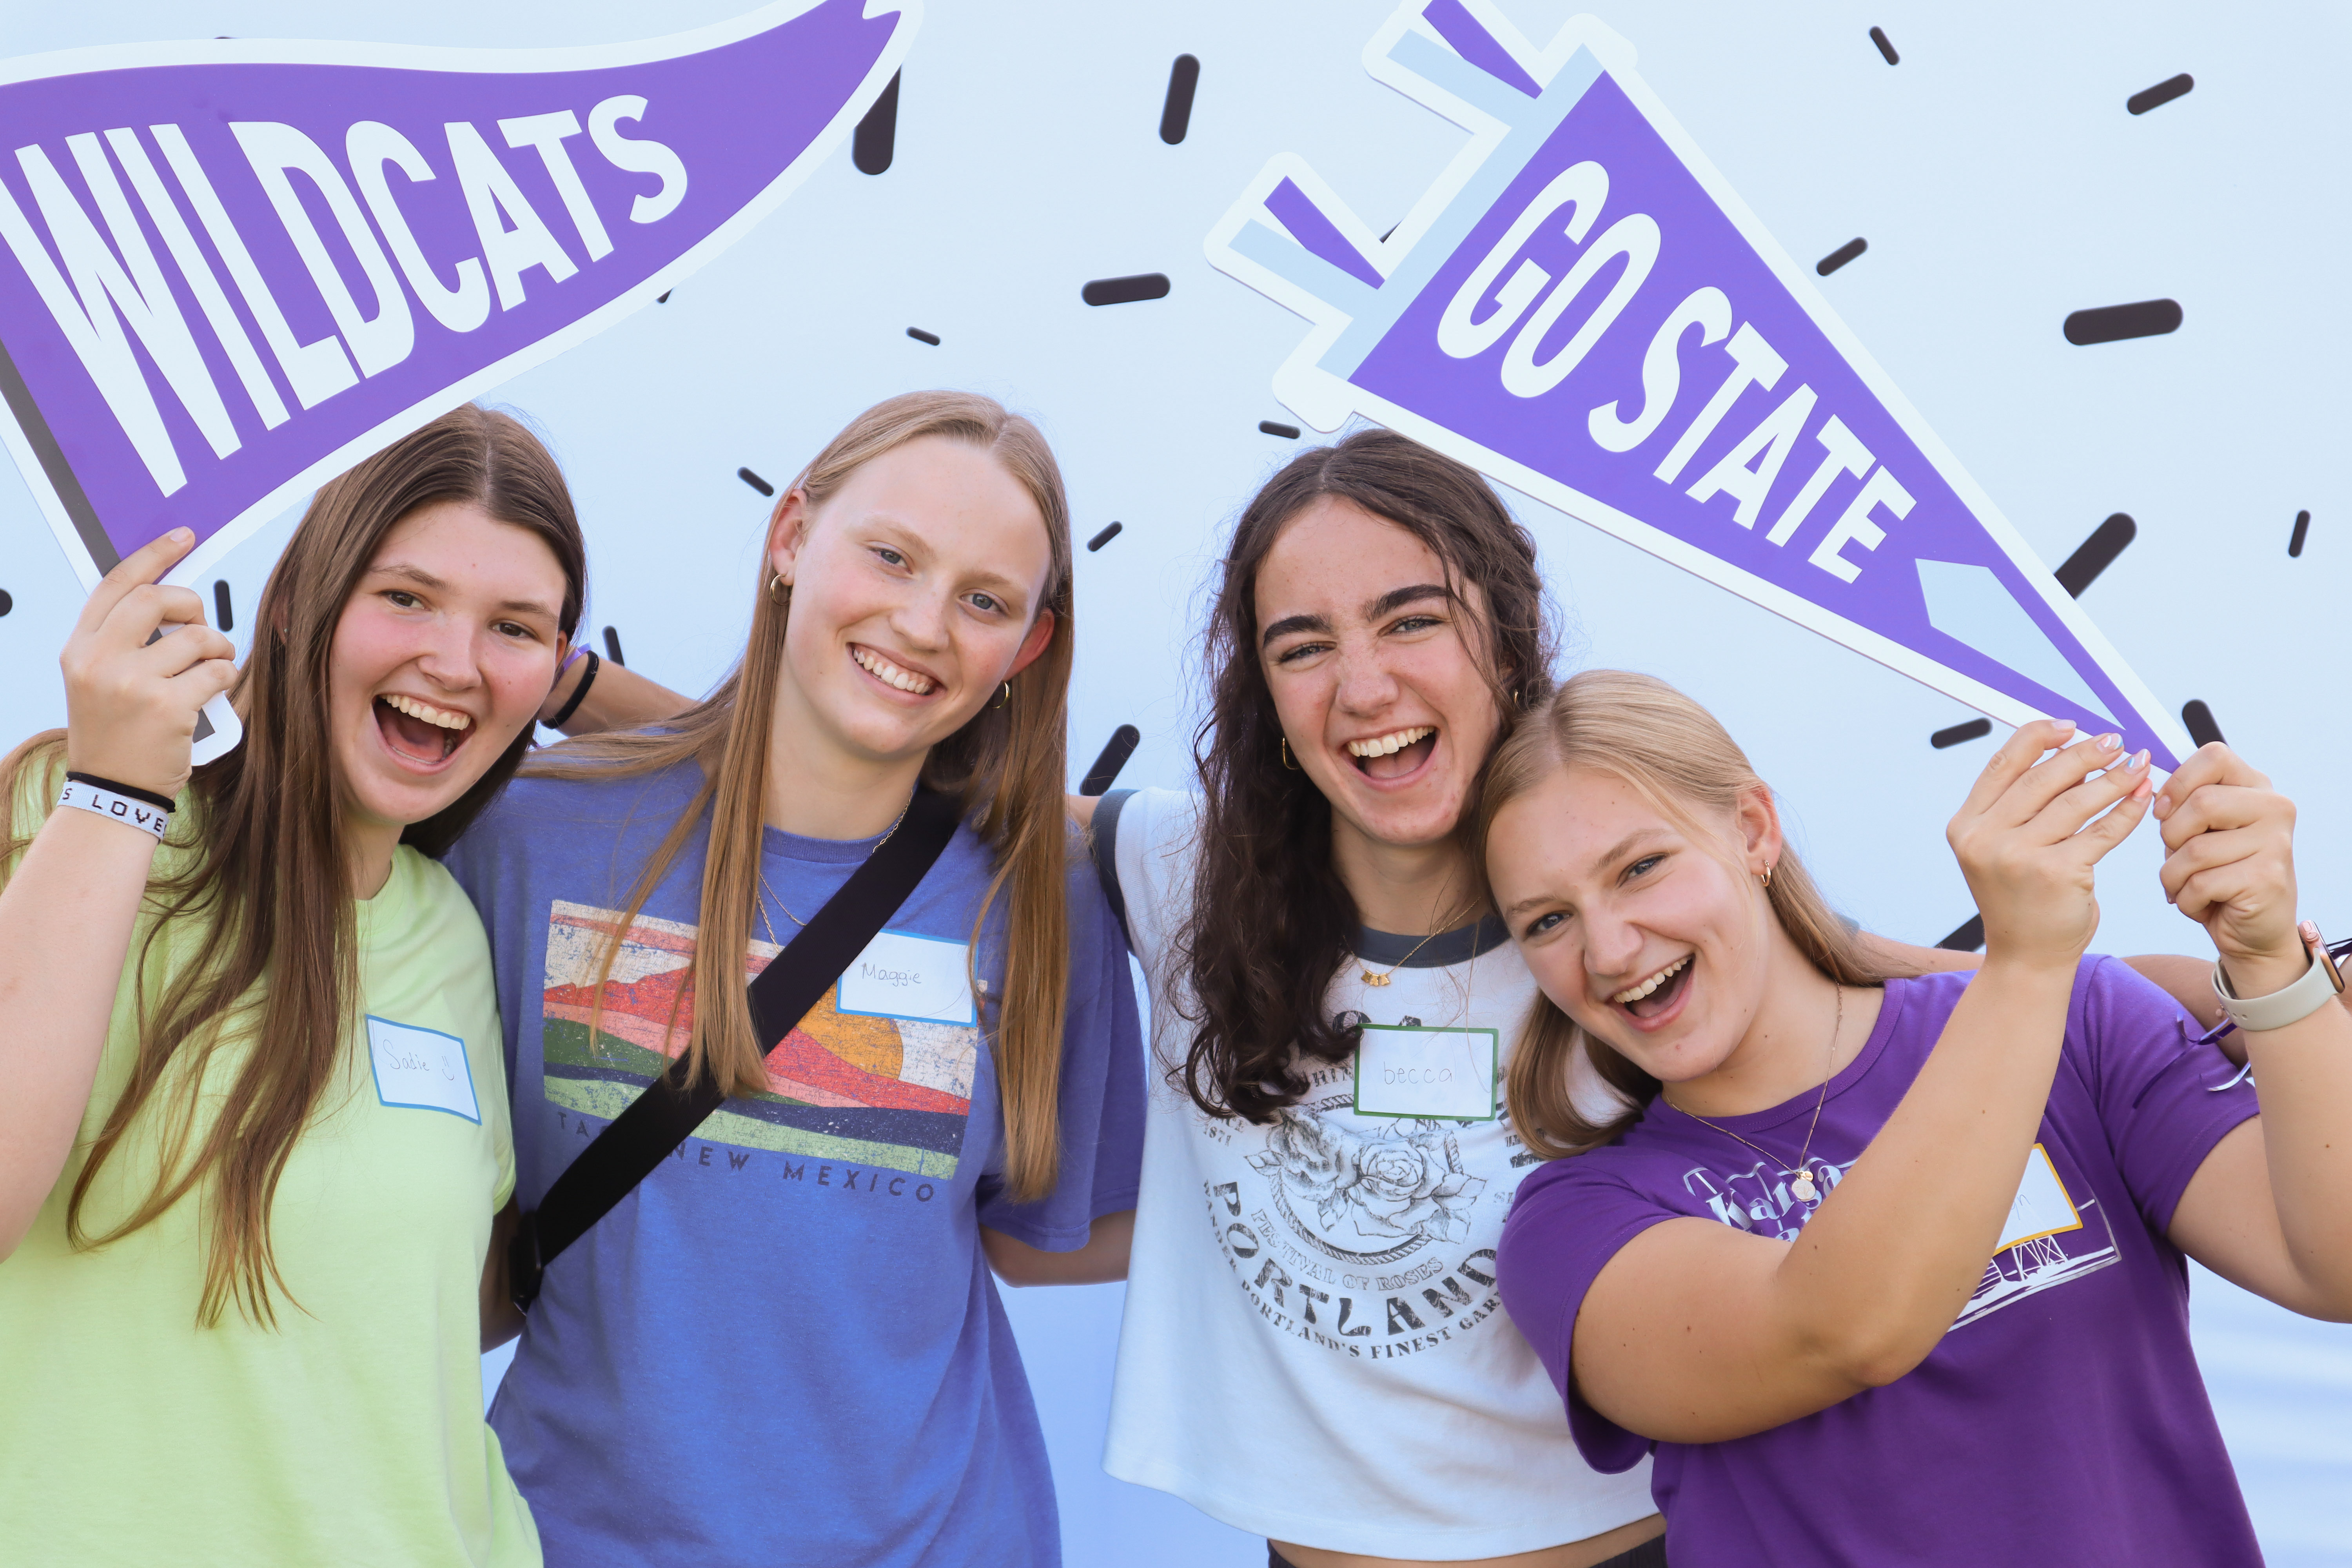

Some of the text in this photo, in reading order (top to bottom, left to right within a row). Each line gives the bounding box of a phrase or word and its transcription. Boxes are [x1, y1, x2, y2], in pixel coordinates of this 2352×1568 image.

[0, 94, 688, 497] WILDCATS
[1437, 160, 1917, 584] GO STATE
[92, 794, 167, 837] LOVE
[862, 962, 922, 987] Maggie
[383, 1039, 430, 1071] Sadie
[1383, 1061, 1452, 1085] becca
[782, 1160, 934, 1202] MEXICO
[1213, 1181, 1497, 1337] PORTLAND
[1251, 1209, 1443, 1291] FESTIVAL OF ROSES
[1241, 1279, 1360, 1357] PORTLAND'S
[1370, 1327, 1452, 1359] FINEST
[1459, 1290, 1501, 1330] GAR
